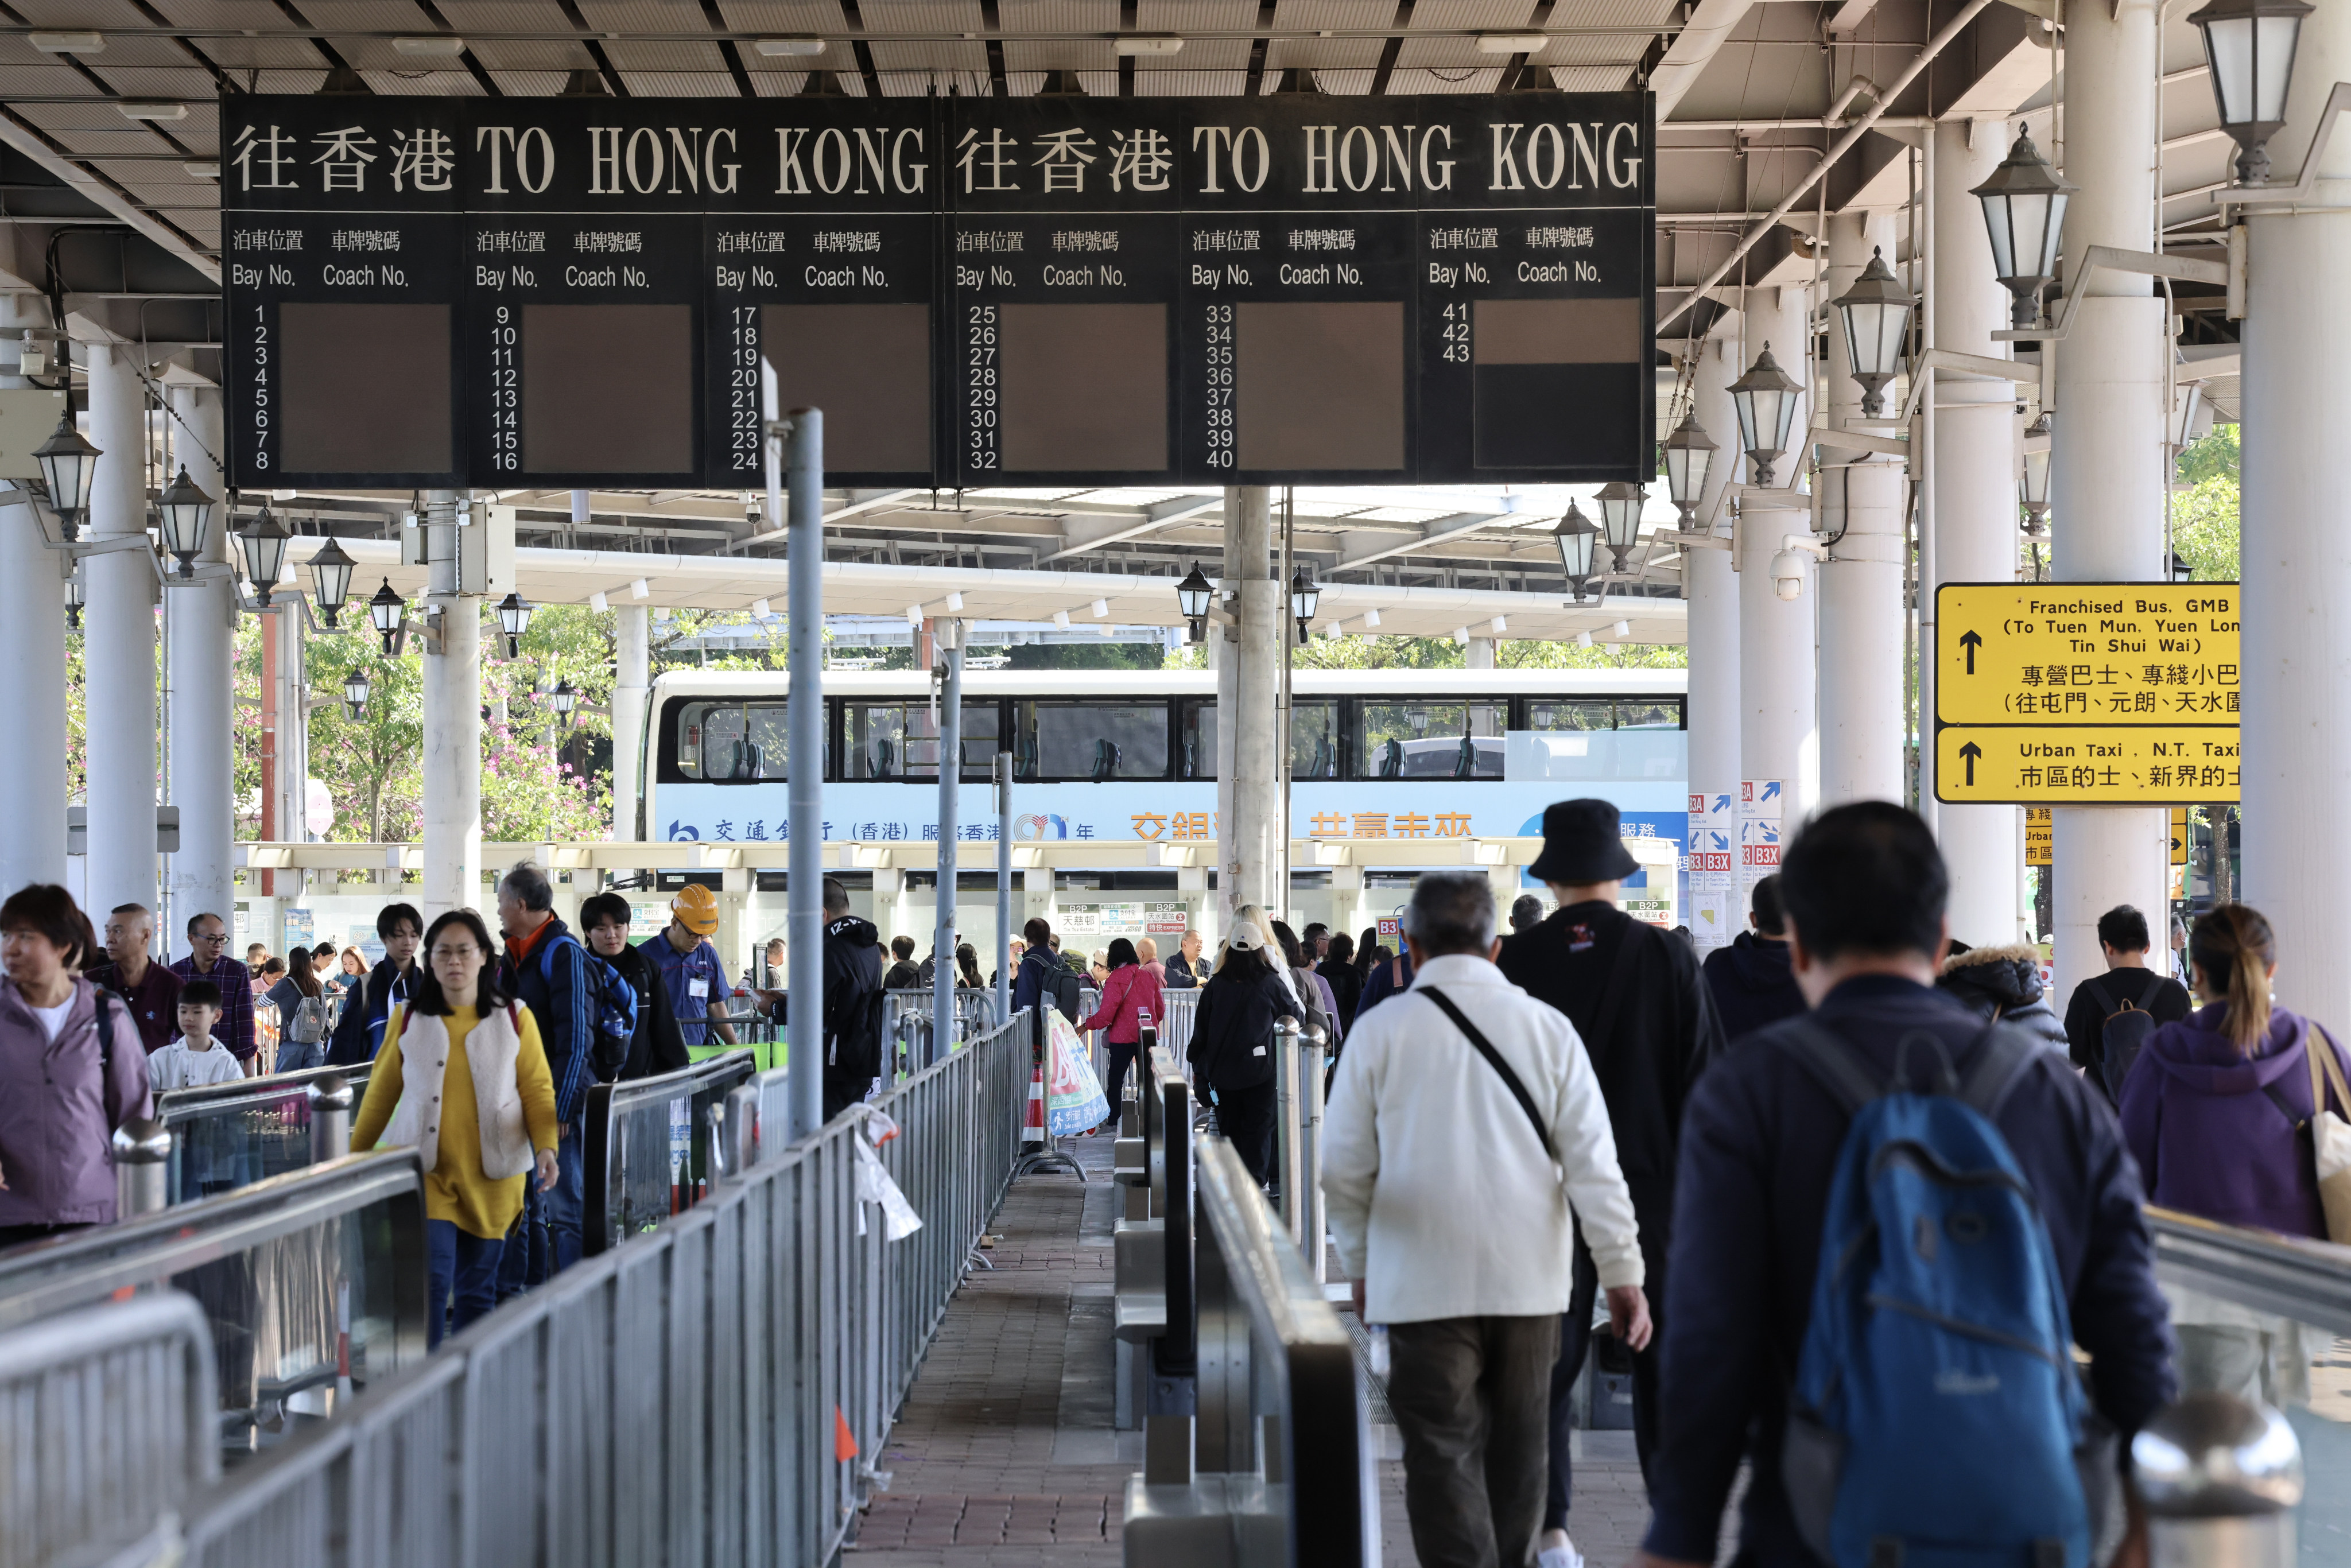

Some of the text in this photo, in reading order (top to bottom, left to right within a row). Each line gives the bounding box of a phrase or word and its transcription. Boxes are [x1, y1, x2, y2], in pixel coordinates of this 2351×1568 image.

[231, 125, 455, 192] 往香港
[477, 127, 928, 193] TO HONG KONG
[956, 128, 1173, 193] 往香港
[1193, 122, 1642, 192] TO HONG KONG
[234, 229, 400, 251] 泊車位置 車牌號碼
[477, 231, 642, 253] 泊車位置 車牌號碼
[717, 231, 880, 253] 泊車位置 車牌號碼
[957, 231, 1119, 252] 泊車位置 車牌號碼
[1193, 229, 1355, 251] 泊車位置 車牌號碼
[1430, 227, 1593, 249] 泊車位置 車牌號碼
[233, 264, 408, 290] Bay No. Coach No.
[477, 266, 649, 291] Bay No. Coach No.
[717, 266, 888, 292] Bay No. Coach No.
[957, 265, 1126, 291] Bay No. Coach No.
[1193, 264, 1363, 290] Bay No. Coach No.
[1430, 261, 1601, 288] Bay No. Coach No.
[255, 305, 262, 322] 1
[497, 306, 509, 324] 9
[732, 307, 756, 324] 17
[970, 306, 995, 323] 25
[1207, 305, 1231, 323] 33
[1443, 303, 1465, 320] 41
[255, 327, 267, 343] 2
[492, 328, 515, 344] 10
[732, 328, 756, 345] 18
[970, 327, 995, 344] 26
[1207, 326, 1231, 343] 34
[1443, 324, 1468, 341] 42
[255, 347, 267, 364] 3
[492, 348, 511, 365] 11
[733, 348, 756, 366] 19
[970, 348, 995, 365] 27
[1207, 347, 1232, 364] 35
[1443, 344, 1469, 362] 43
[255, 368, 267, 385] 4
[492, 370, 516, 386] 12
[732, 370, 756, 386] 20
[971, 368, 995, 386] 28
[1207, 368, 1232, 385] 36
[256, 389, 267, 406] 5
[492, 390, 516, 407] 13
[732, 390, 754, 407] 21
[971, 389, 995, 406] 29
[1208, 389, 1232, 405] 37
[256, 410, 267, 427] 6
[493, 411, 517, 428] 14
[732, 411, 757, 428] 22
[971, 410, 995, 427] 30
[1208, 409, 1232, 426] 38
[257, 431, 267, 448] 7
[493, 432, 517, 449] 15
[732, 432, 758, 449] 23
[971, 431, 992, 448] 31
[1208, 430, 1232, 447] 39
[257, 452, 268, 469] 8
[493, 453, 517, 469] 16
[733, 453, 758, 469] 24
[971, 452, 996, 468] 32
[1207, 451, 1232, 467] 40
[2031, 599, 2229, 614] Franchised Bus, GMB
[2004, 619, 2034, 635] (To
[2046, 620, 2087, 633] Tuen
[2101, 620, 2141, 633] Mun,
[2155, 619, 2197, 632] Yuen
[2070, 638, 2201, 655] Tin Shui Wai)
[2022, 663, 2239, 687] 專營巴士、專綫小巴
[2020, 743, 2075, 757] Urban
[2154, 743, 2189, 756] N.T.
[1689, 796, 1702, 812] B3A
[1076, 824, 1094, 840] 年
[1756, 848, 1778, 863] B3X
[2026, 847, 2052, 859] 市區
[1690, 855, 1729, 869] B3 B3X
[1069, 905, 1088, 913] B2P
[1156, 903, 1175, 911] B2P
[1549, 902, 1559, 910] B2
[1639, 902, 1658, 910] B2P
[1063, 915, 1095, 926] 天慈邨
[1149, 923, 1163, 932] 特快
[1380, 921, 1396, 934] B3
